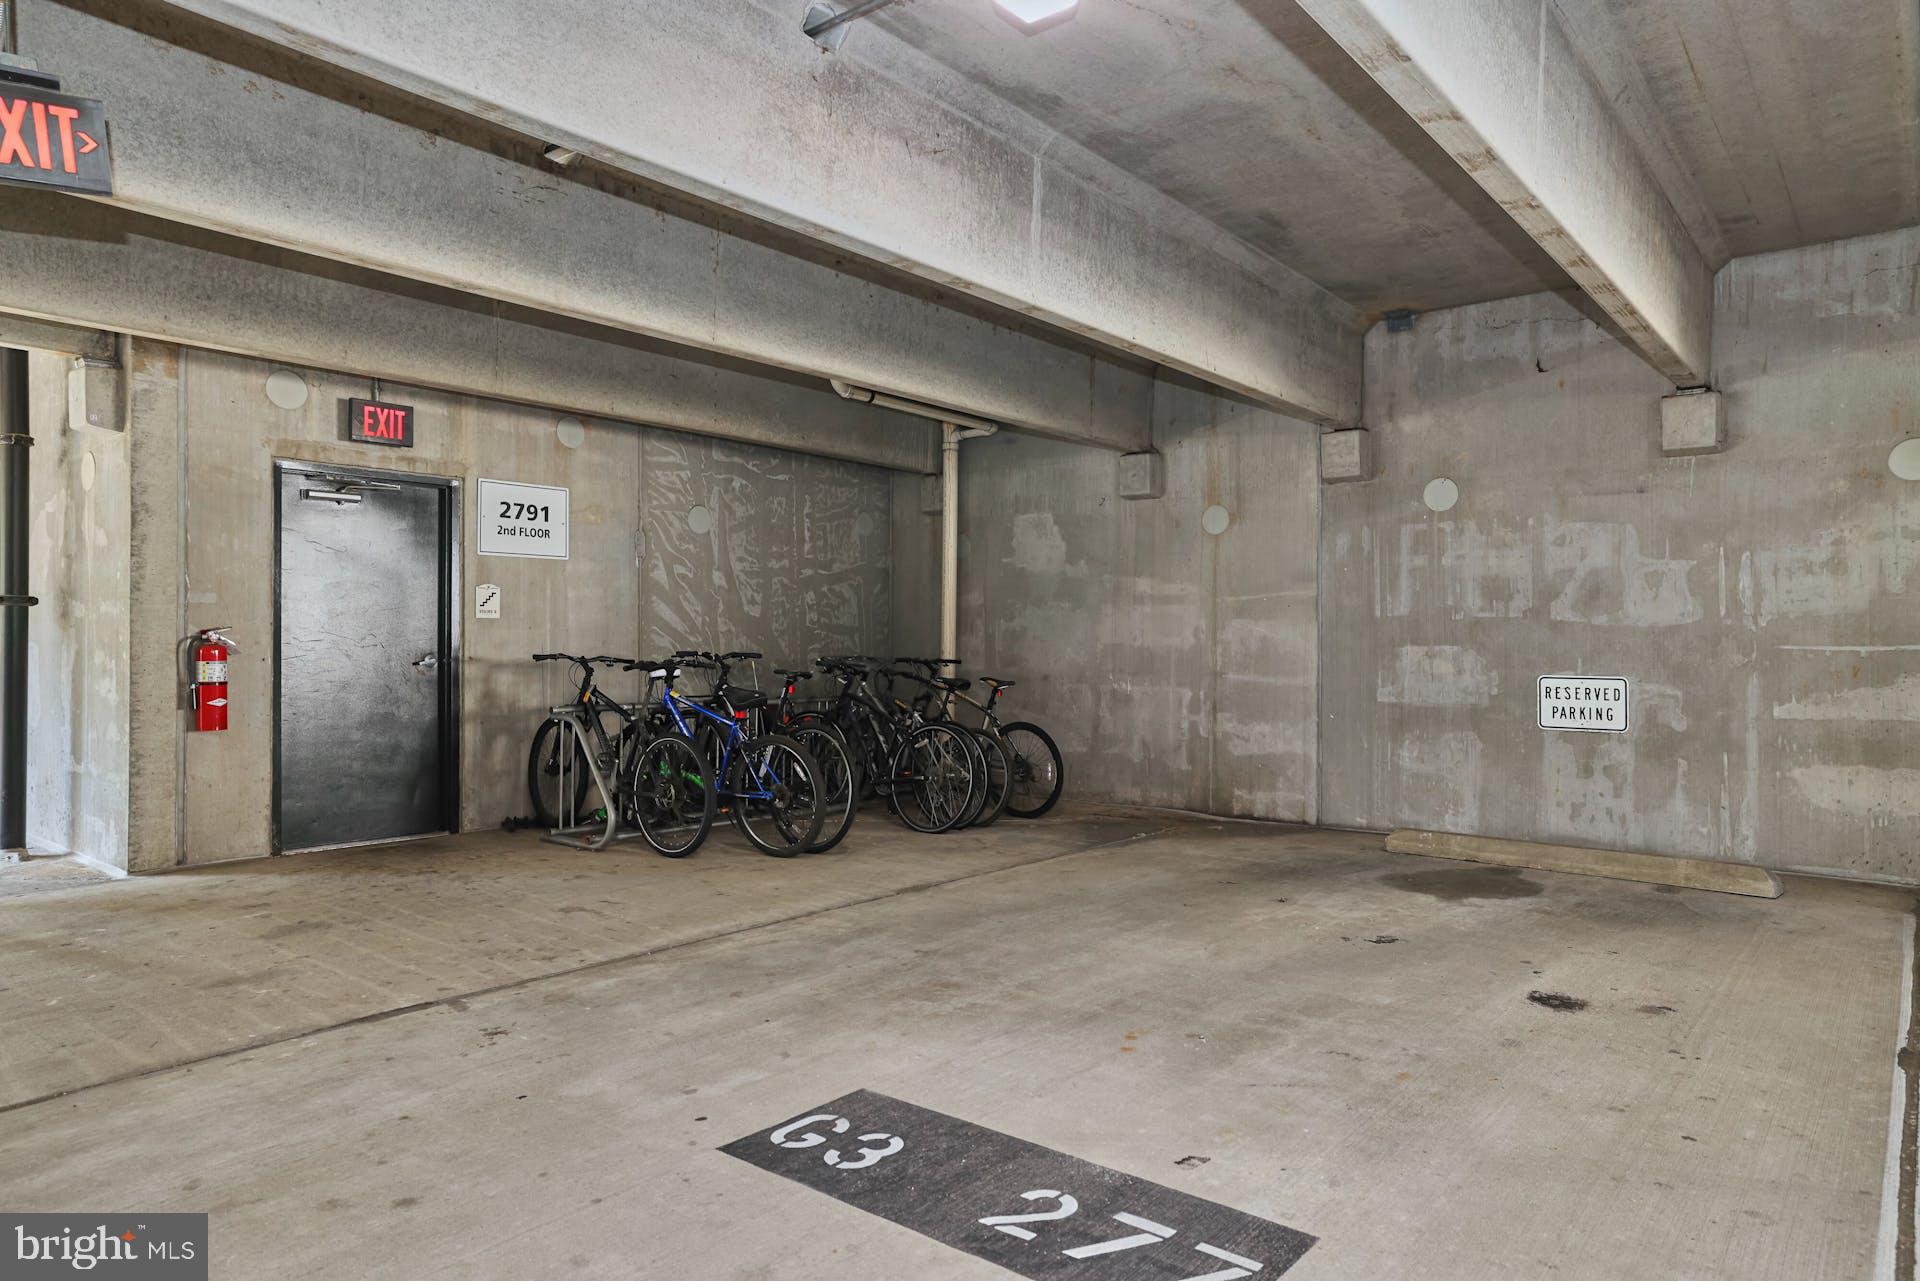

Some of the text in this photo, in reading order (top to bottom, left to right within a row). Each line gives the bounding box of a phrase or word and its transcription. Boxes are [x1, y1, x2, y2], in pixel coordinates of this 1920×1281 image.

[364, 405, 405, 440] EXIT
[500, 501, 549, 522] 2791
[497, 525, 551, 539] 2nd FLOOR
[1545, 686, 1620, 702] RESERVED
[1552, 706, 1613, 721] PARKING
[770, 1114, 904, 1169] G3
